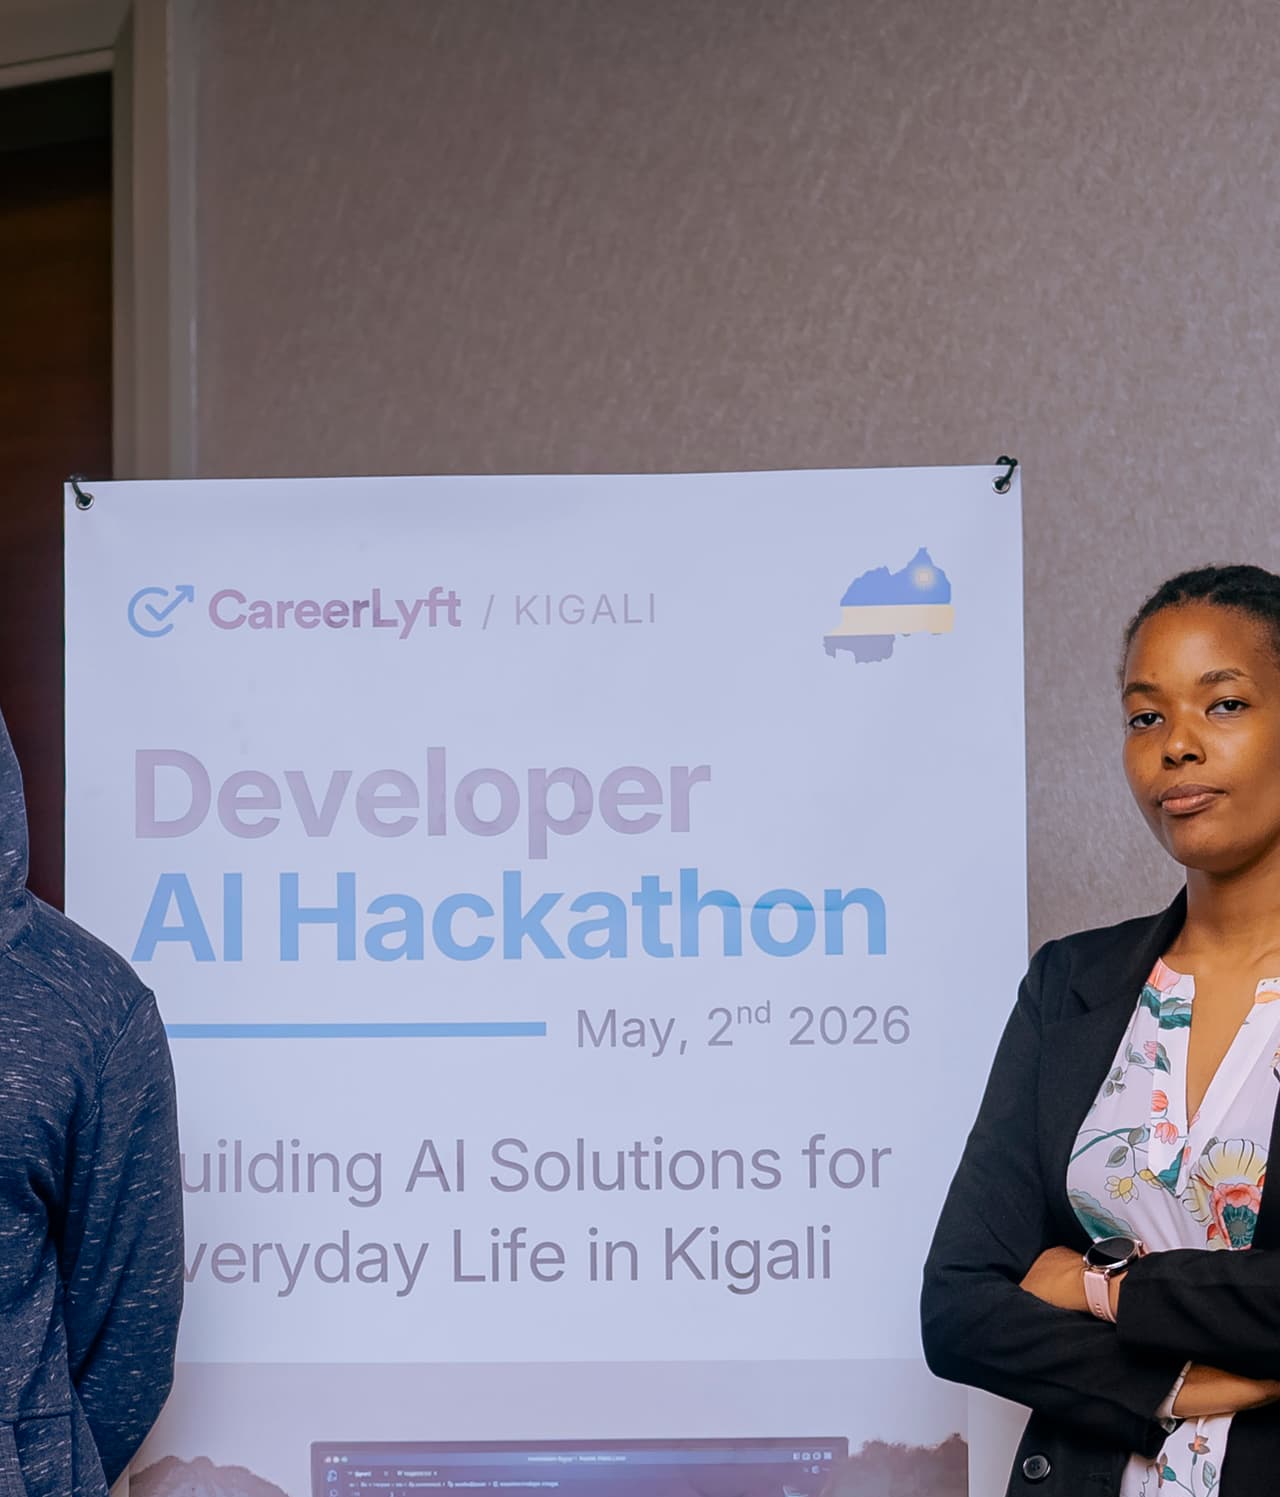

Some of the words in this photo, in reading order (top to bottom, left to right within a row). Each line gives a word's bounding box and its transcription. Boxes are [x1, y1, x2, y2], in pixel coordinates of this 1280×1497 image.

[208, 586, 462, 639] CareerLyft
[515, 592, 655, 626] KIGALI
[134, 746, 712, 860] Developer
[131, 872, 243, 962] AI
[279, 867, 887, 962] Hackathon
[577, 1008, 688, 1058] May,
[707, 1000, 771, 1047] 2nd
[789, 1004, 911, 1046] 2026
[180, 1138, 382, 1207] uilding
[405, 1138, 465, 1193] AI
[490, 1135, 782, 1193] Solutions
[801, 1133, 893, 1190] for
[184, 1229, 430, 1298] veryday
[453, 1226, 566, 1283] Life
[588, 1226, 638, 1282] in
[664, 1224, 831, 1296] Kigali
